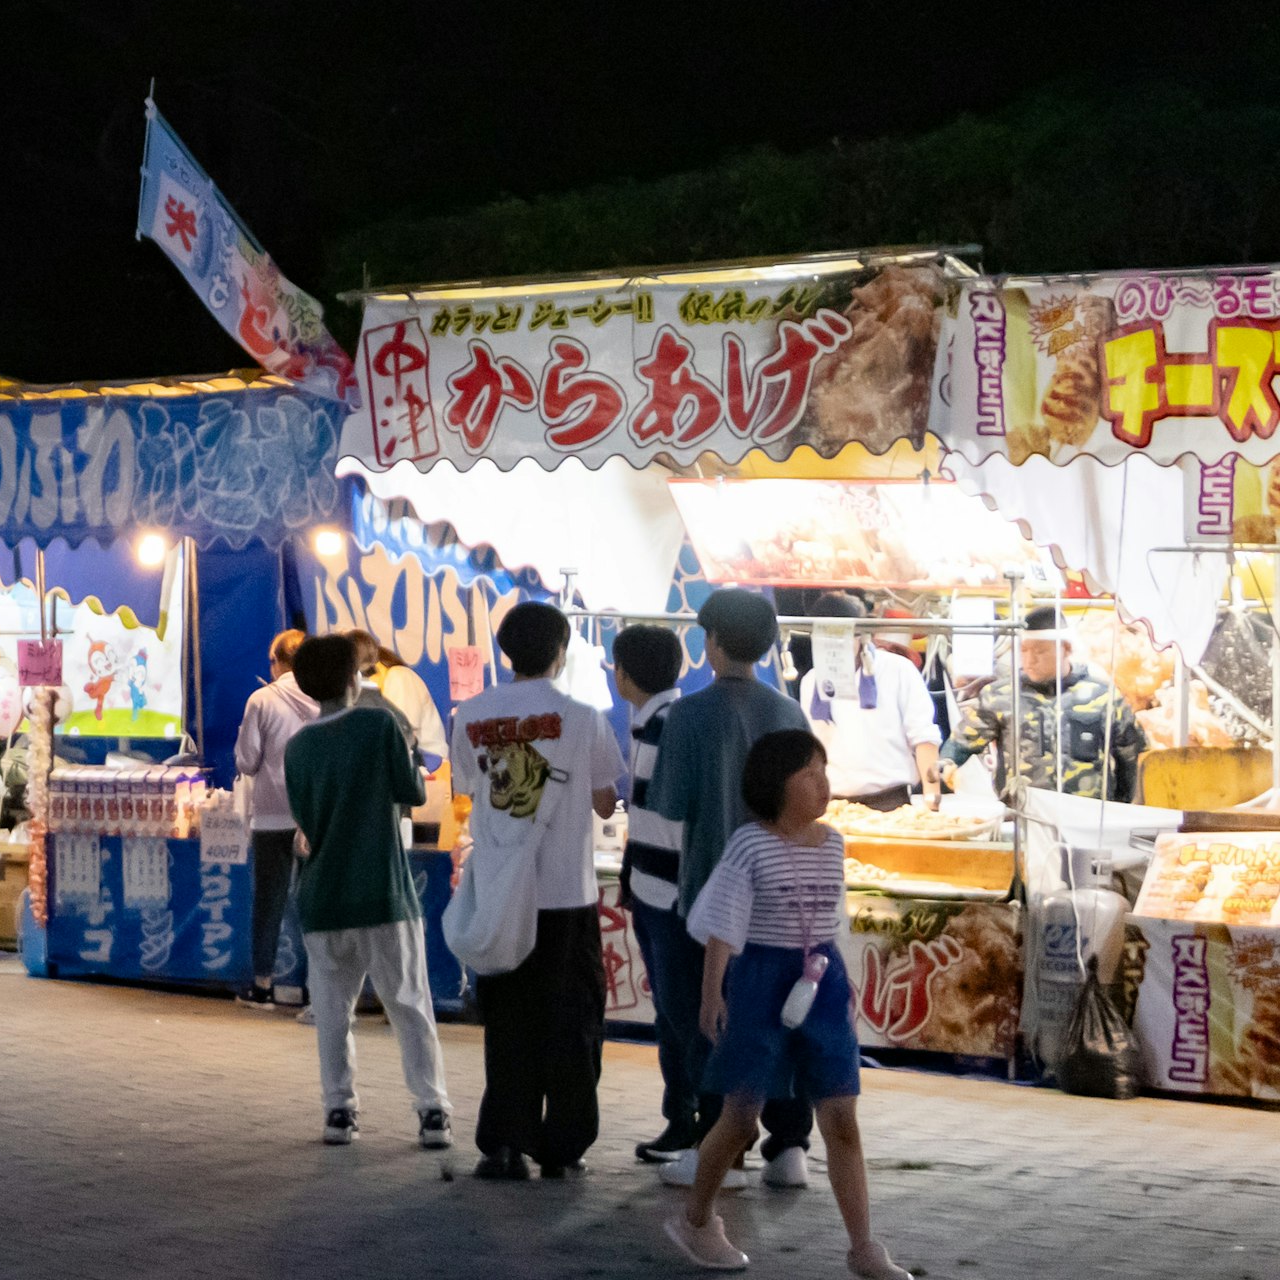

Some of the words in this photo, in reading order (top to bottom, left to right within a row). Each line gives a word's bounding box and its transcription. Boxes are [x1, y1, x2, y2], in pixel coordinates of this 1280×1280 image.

[373, 323, 430, 458] 中津
[444, 310, 851, 453] からあげ
